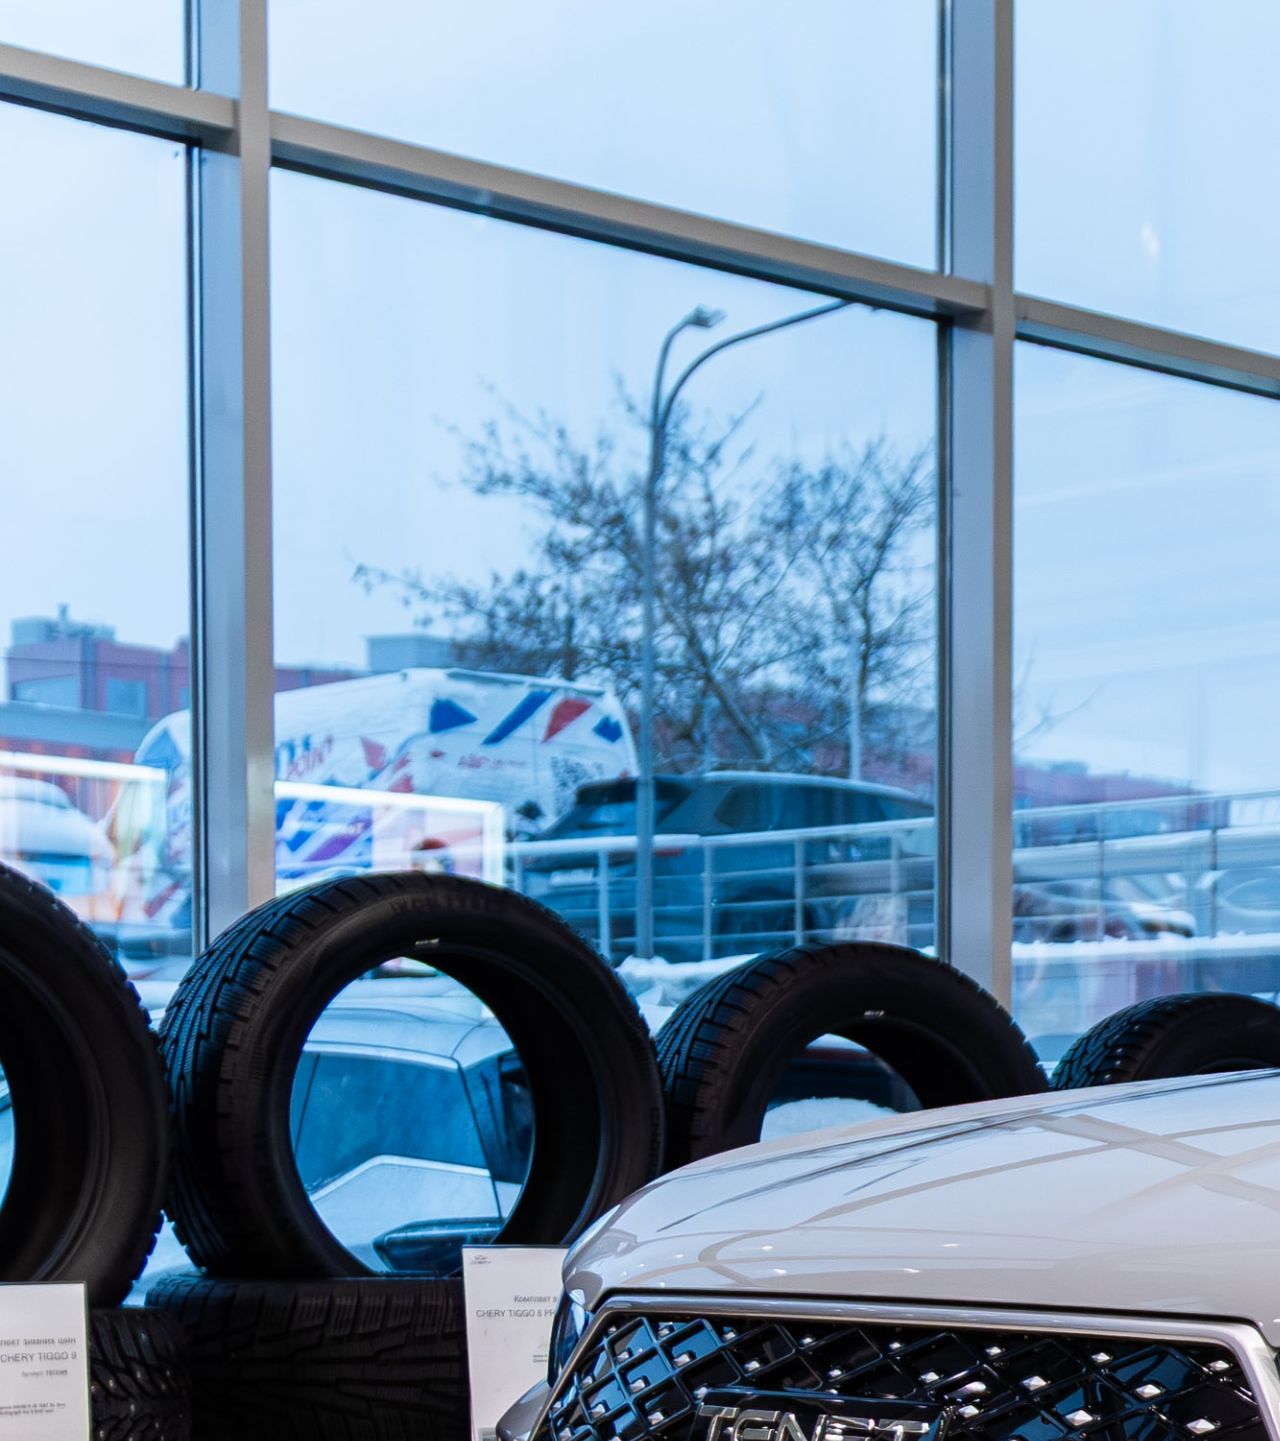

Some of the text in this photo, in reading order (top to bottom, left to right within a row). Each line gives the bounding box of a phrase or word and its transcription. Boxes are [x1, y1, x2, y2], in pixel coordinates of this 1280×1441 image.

[476, 1309, 505, 1318] CHERY
[509, 1309, 536, 1318] TIGGO
[0, 1353, 34, 1363] CHERY
[38, 1351, 69, 1361] TIGGO
